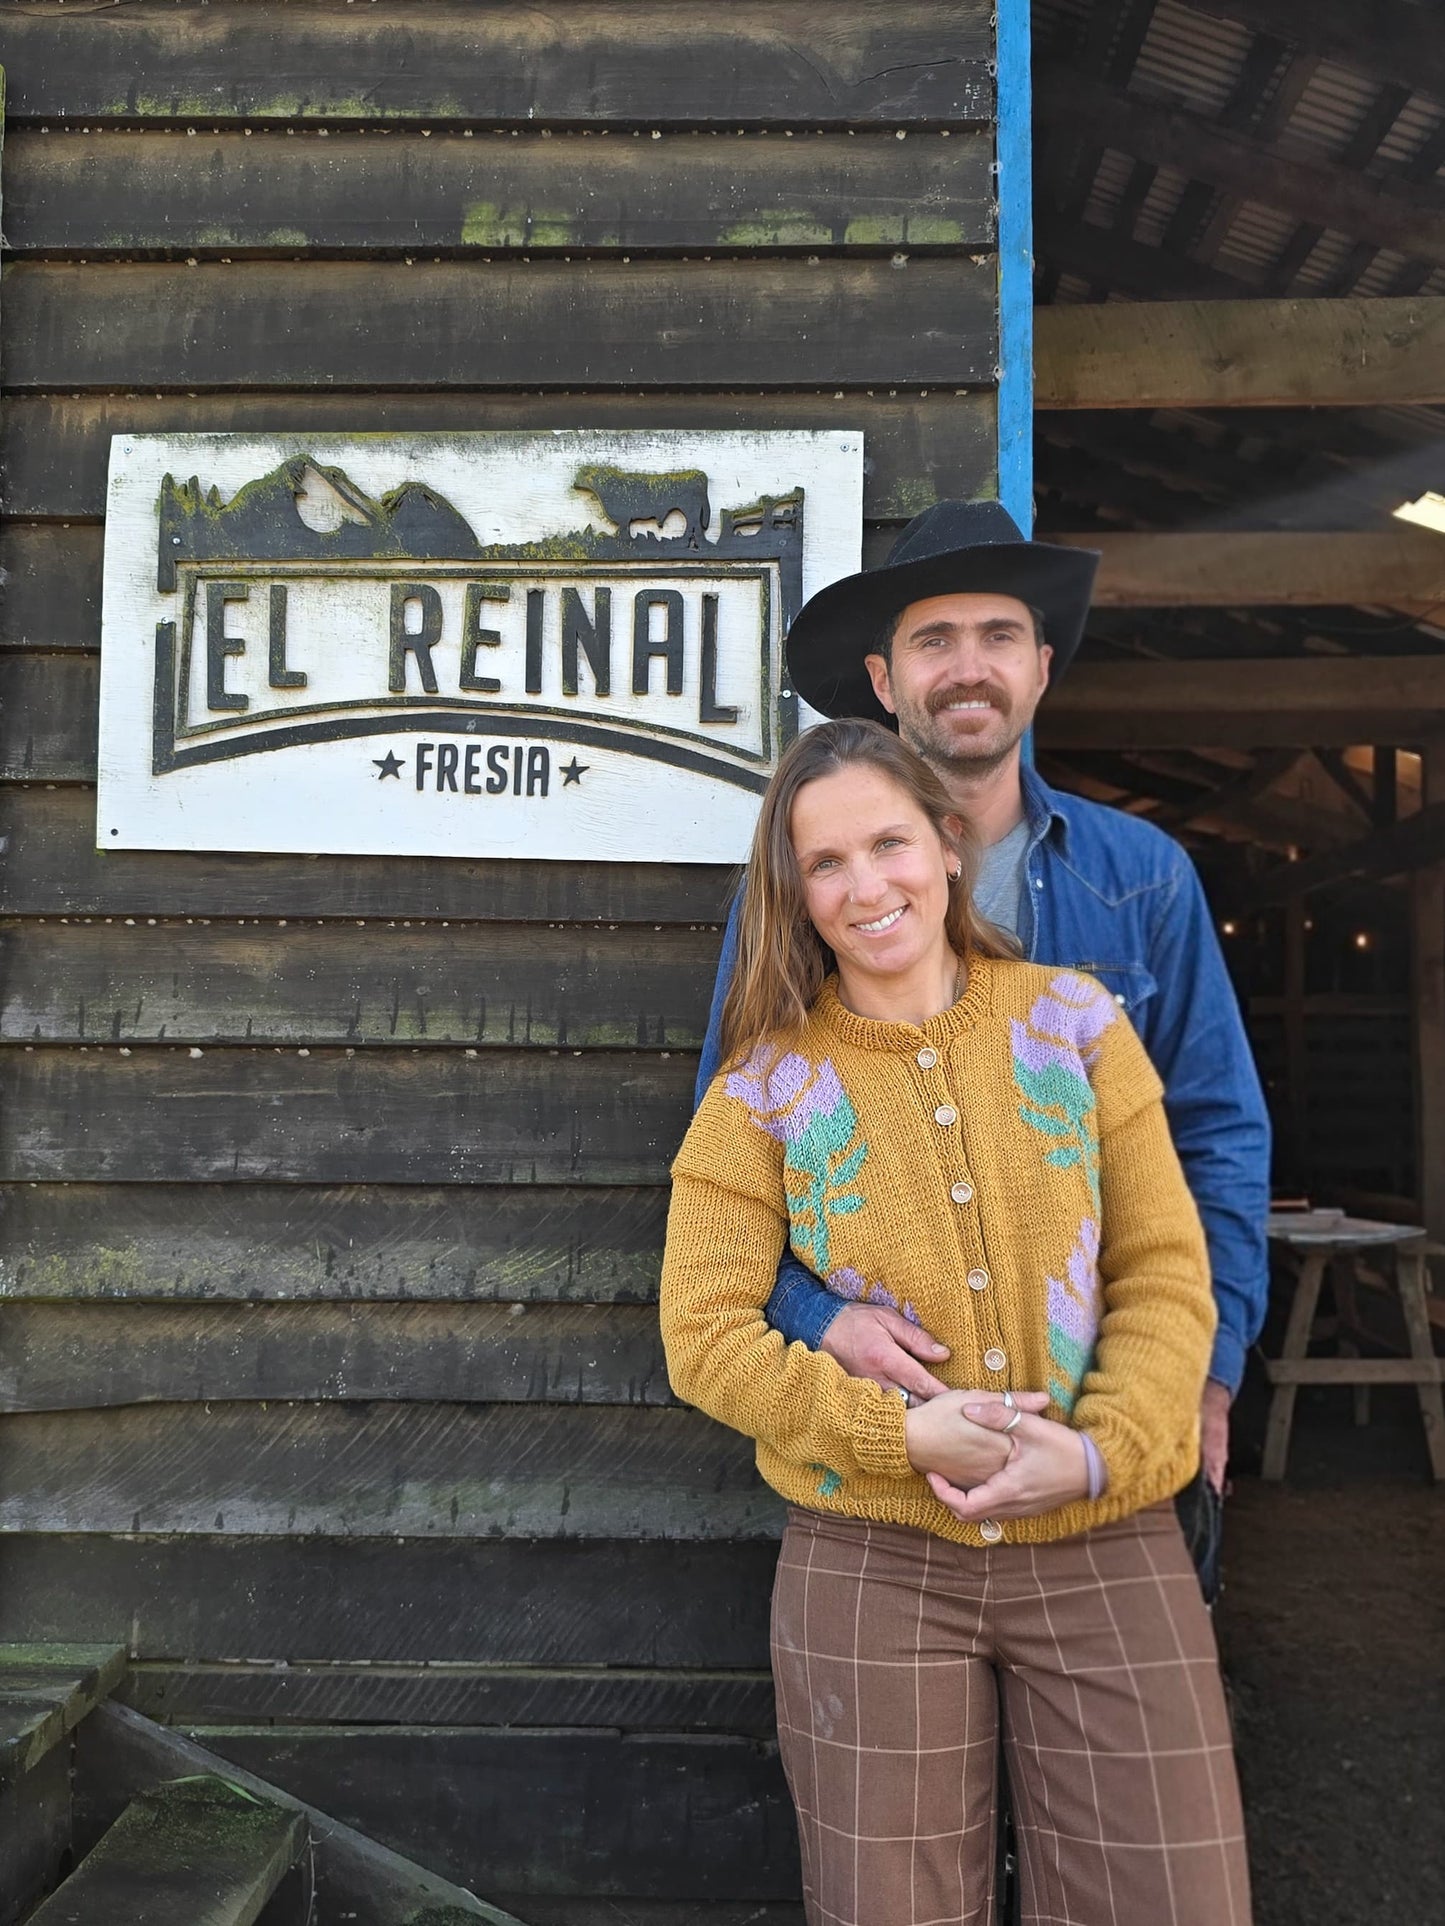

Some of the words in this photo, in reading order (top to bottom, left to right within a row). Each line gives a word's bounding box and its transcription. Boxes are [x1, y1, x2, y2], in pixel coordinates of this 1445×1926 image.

[206, 583, 307, 711] EL
[389, 583, 738, 723] REINAL
[416, 743, 550, 797] FRESIA
